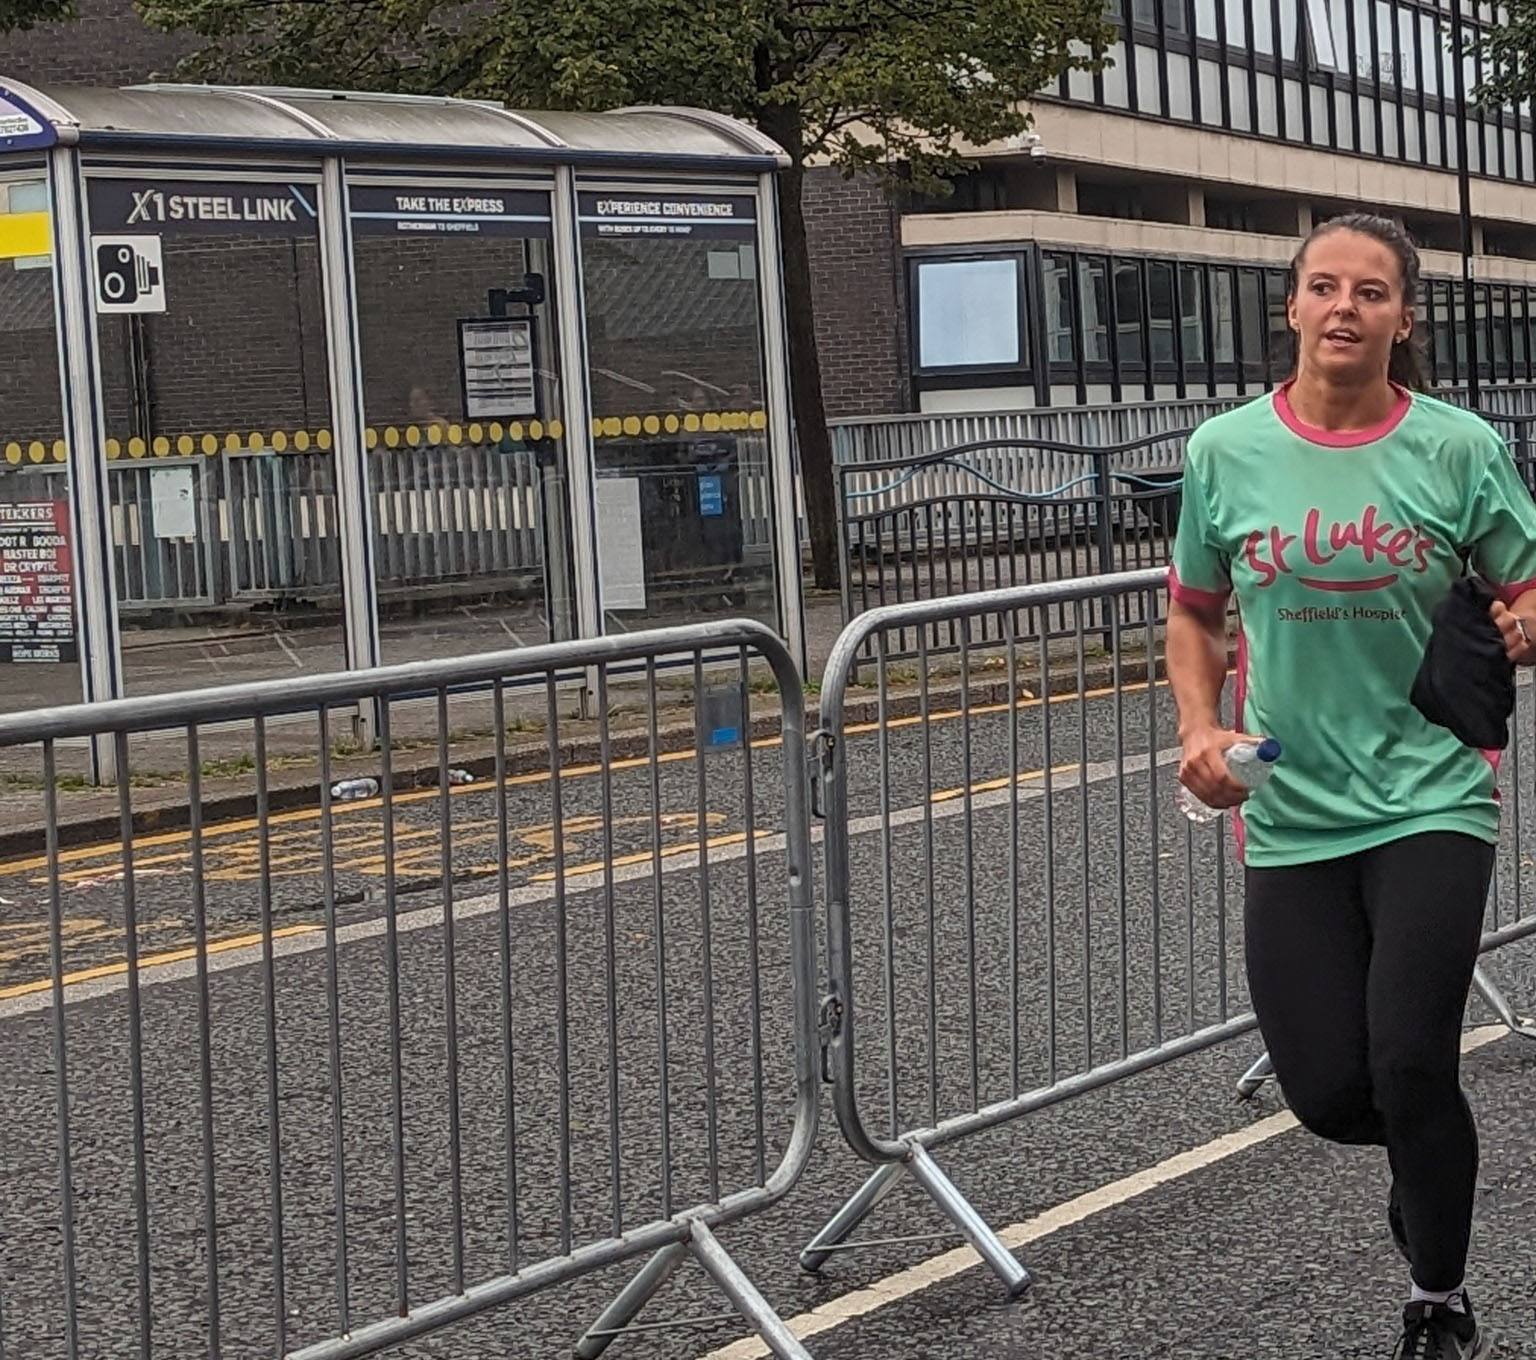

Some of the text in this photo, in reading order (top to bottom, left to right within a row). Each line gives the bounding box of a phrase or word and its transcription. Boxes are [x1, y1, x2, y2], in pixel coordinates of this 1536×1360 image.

[126, 190, 297, 224] X1 STEEL LINK
[396, 197, 504, 213] TAKE THE EXPRESS
[597, 201, 733, 216] EXPERIENCE CONVENIENCE
[1304, 505, 1436, 574] Luke's
[1278, 607, 1349, 623] Sheffield's
